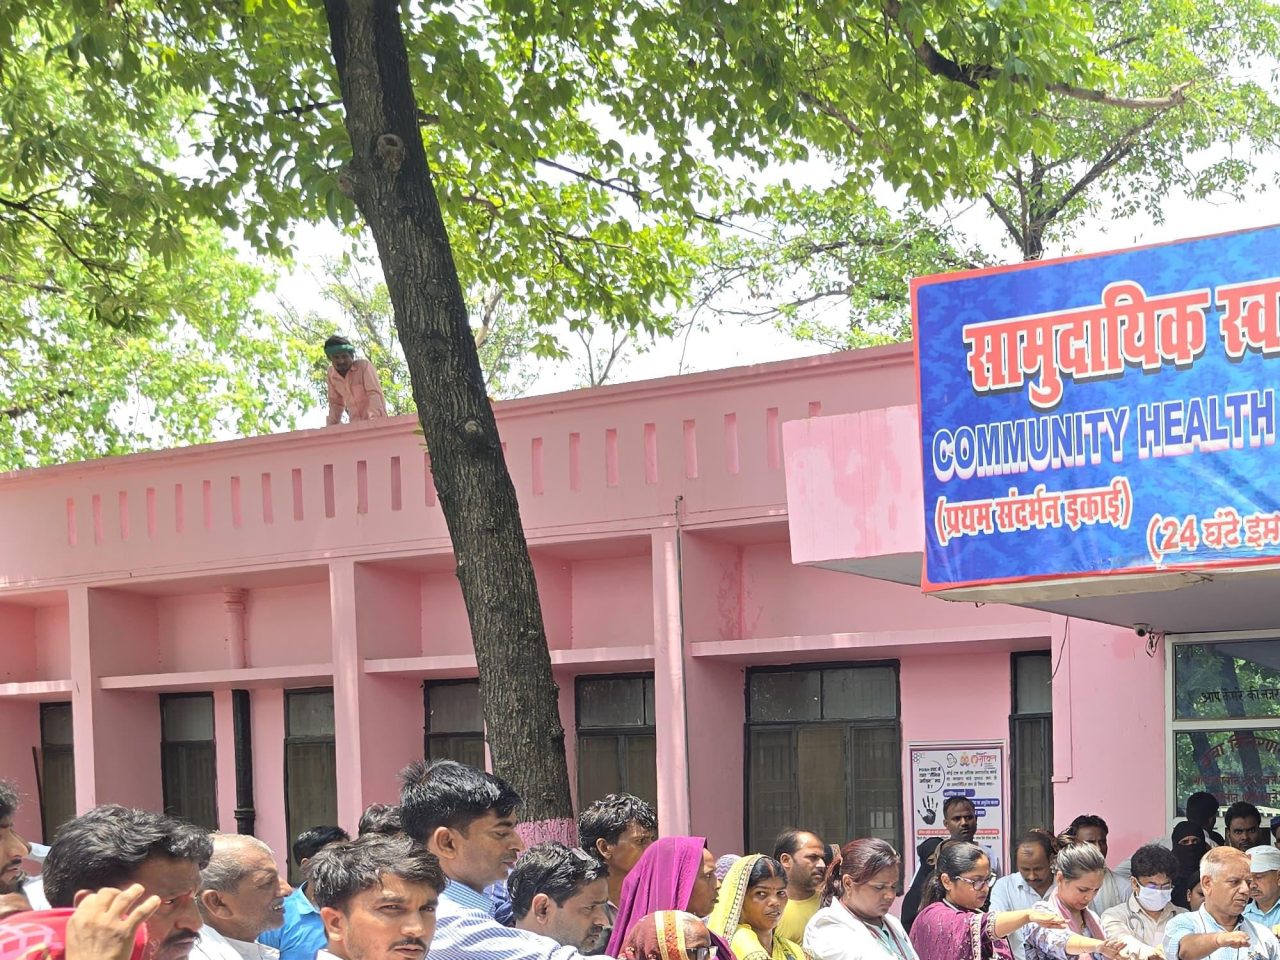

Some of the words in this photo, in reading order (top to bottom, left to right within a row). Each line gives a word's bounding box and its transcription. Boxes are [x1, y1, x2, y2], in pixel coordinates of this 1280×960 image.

[964, 280, 1210, 408] सामुदायिक
[934, 406, 1129, 481] COMMUNITY
[1138, 388, 1275, 460] HEALTH
[935, 496, 994, 546] (प्रथम
[1064, 476, 1133, 531] इकाई)
[1147, 513, 1199, 563] (24
